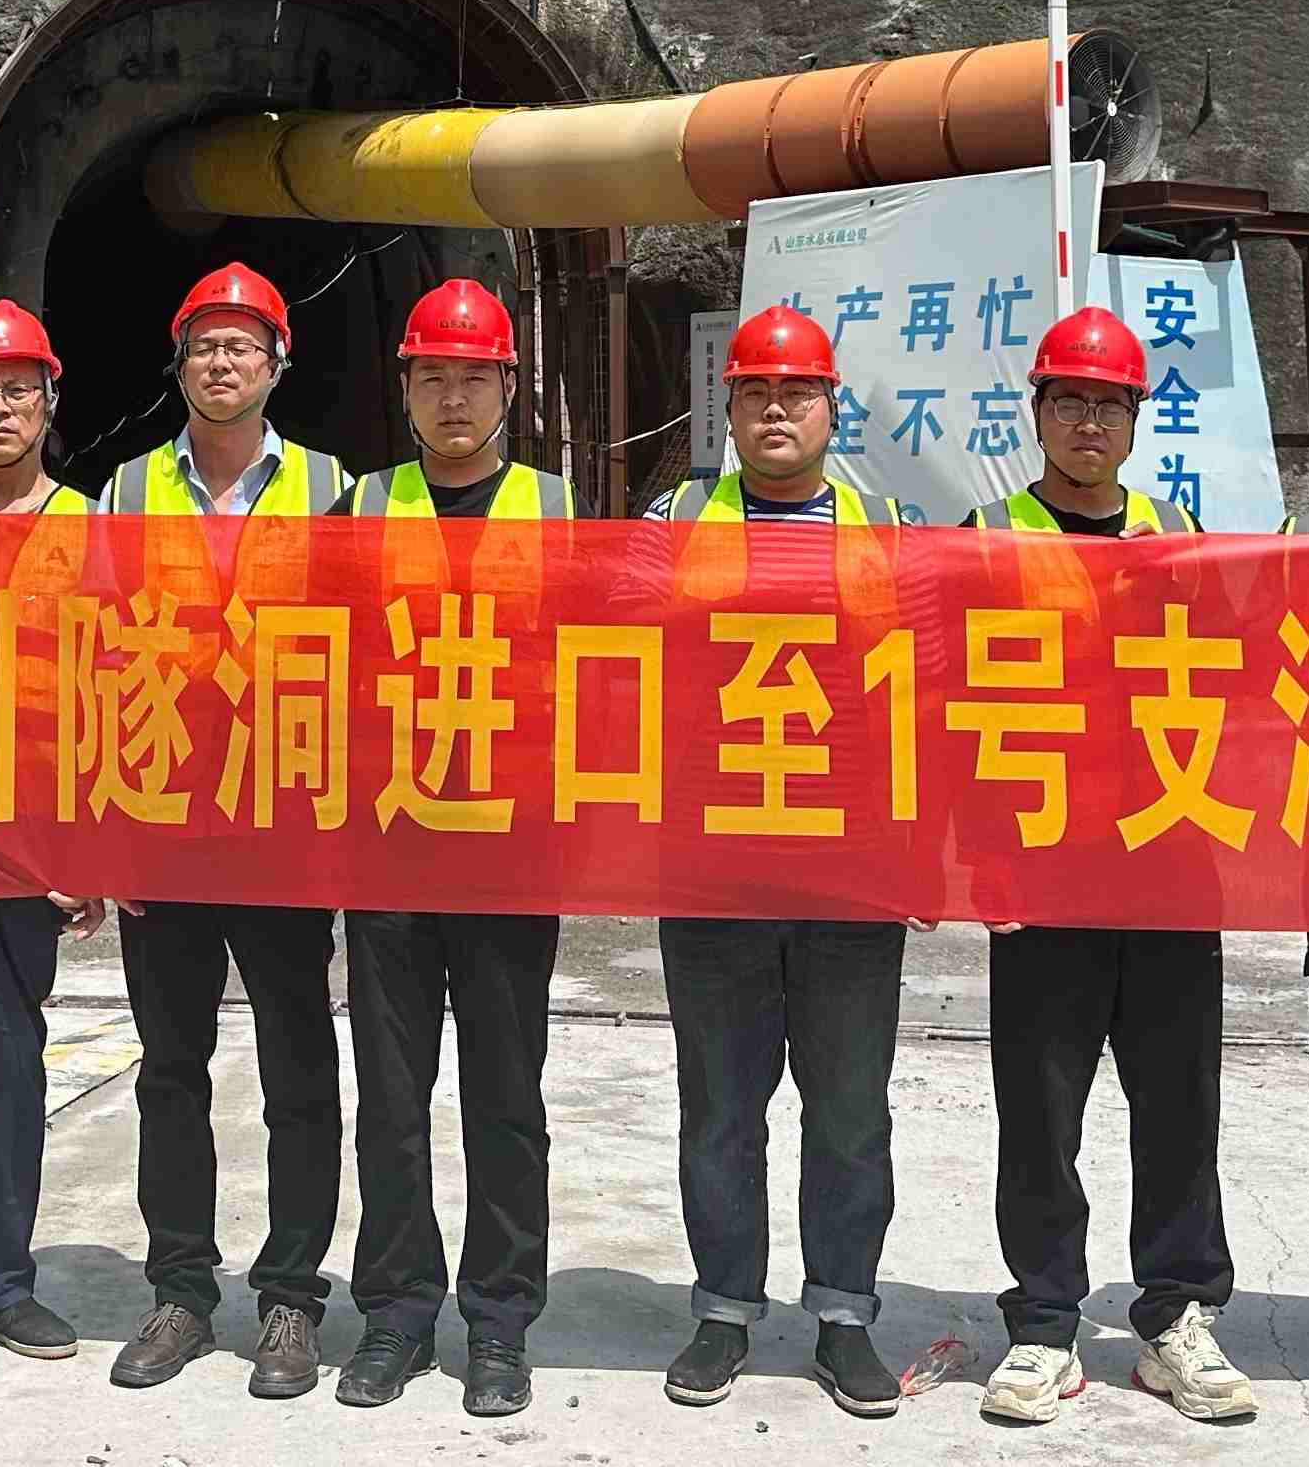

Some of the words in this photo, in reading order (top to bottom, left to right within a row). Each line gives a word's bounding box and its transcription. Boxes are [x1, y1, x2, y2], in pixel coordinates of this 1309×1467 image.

[827, 383, 1024, 457] 全不忘
[1145, 281, 1201, 518] 安全为
